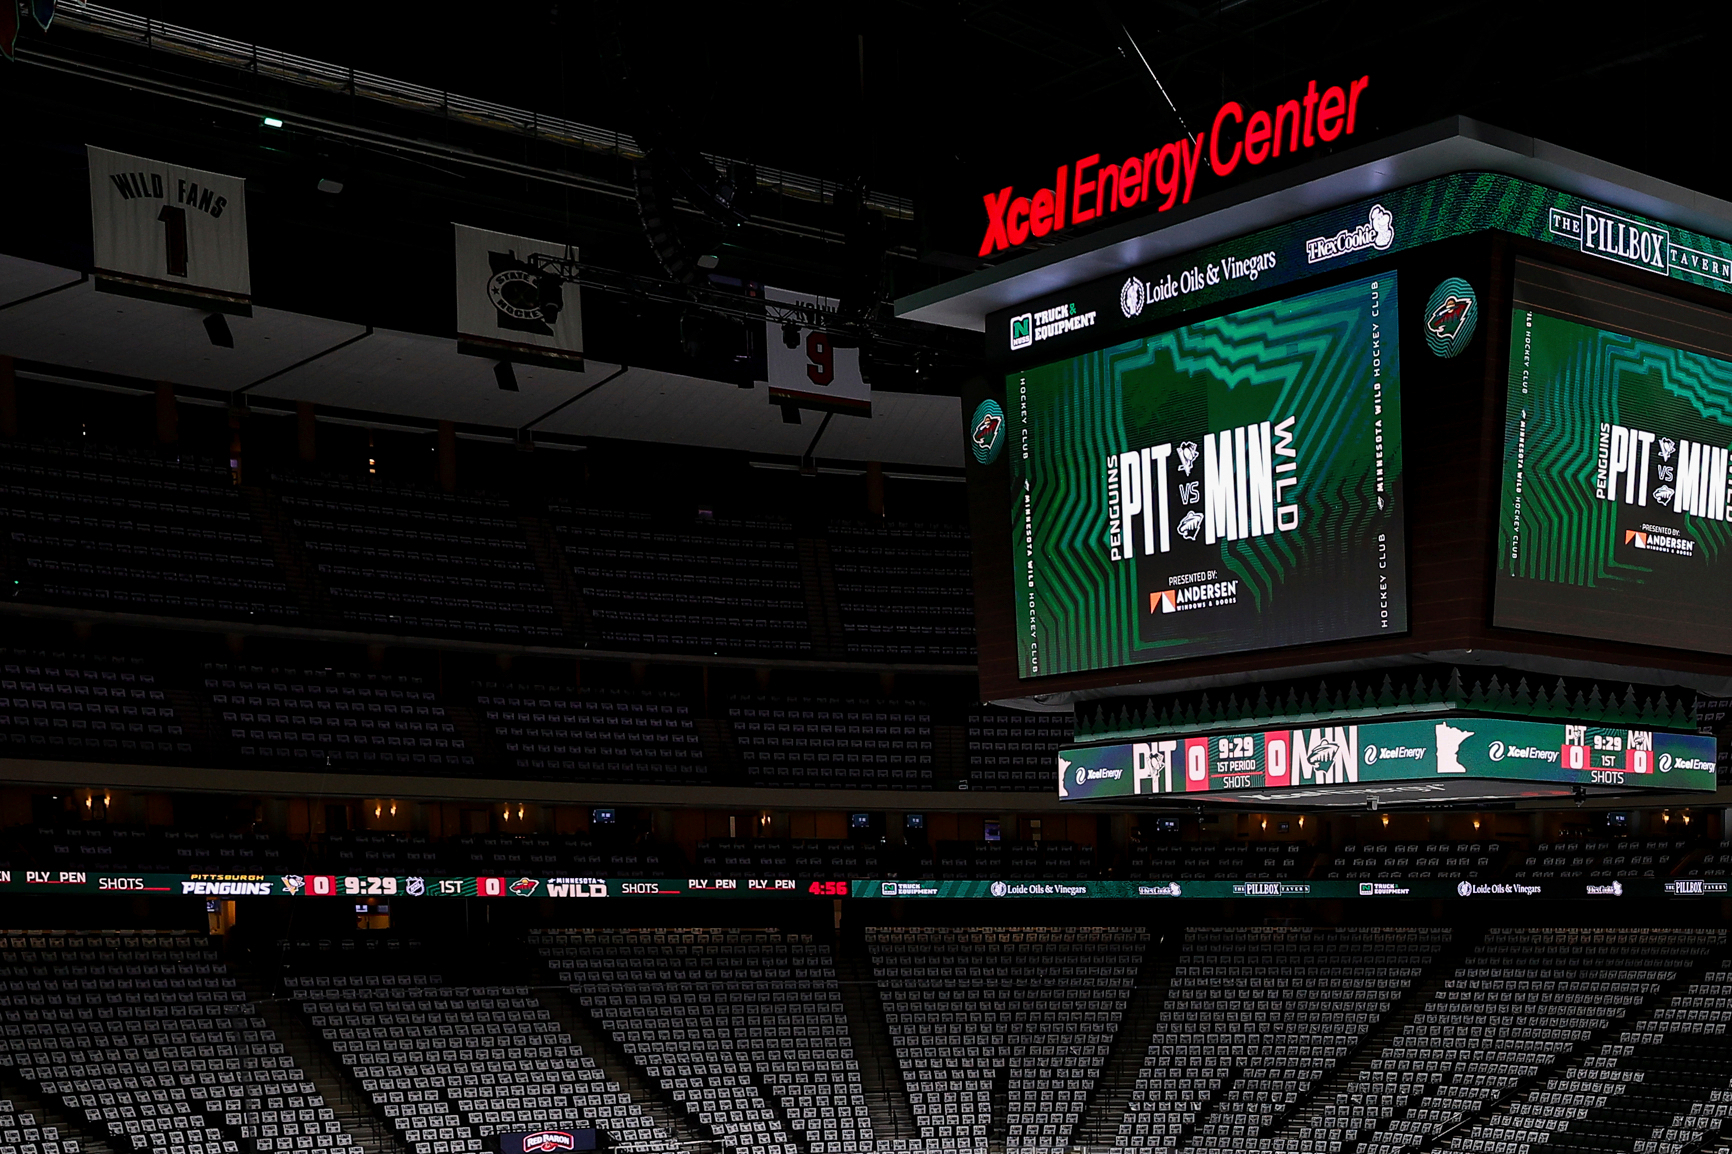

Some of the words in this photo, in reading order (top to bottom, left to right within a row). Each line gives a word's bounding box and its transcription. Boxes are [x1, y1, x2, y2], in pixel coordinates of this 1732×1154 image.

[978, 166, 1067, 257] Xcel
[1071, 133, 1204, 224] Energy
[1209, 75, 1369, 177] Center
[109, 171, 164, 201] WILD
[177, 178, 228, 219] FANS
[157, 205, 188, 278] 1
[1552, 213, 1580, 233] THE
[1584, 215, 1665, 269] PILLBOX
[1670, 248, 1732, 278] TAVERN
[1146, 271, 1177, 307] Loide
[1180, 267, 1205, 299] Oils
[1207, 264, 1219, 286] &
[1221, 249, 1278, 286] Vinegars
[499, 302, 542, 320] HOCKE
[1034, 304, 1068, 326] TRUCK
[1069, 303, 1077, 316] &
[1034, 311, 1096, 342] EQUIPMENT
[806, 331, 834, 386] 9
[1021, 426, 1030, 460] CLUB
[1596, 422, 1611, 499] PENGUINS
[1607, 424, 1656, 507] PIT
[1657, 465, 1674, 481] VS
[1673, 440, 1730, 521] MIN
[1107, 454, 1121, 562] PENGUINS
[1120, 443, 1172, 559] PIT
[1179, 482, 1200, 505] VS
[1204, 421, 1275, 545] MIN
[1273, 415, 1299, 533] WILD
[1646, 533, 1693, 551] ANDERSEN
[1168, 573, 1200, 587] PRESENTED
[1201, 570, 1218, 583] BY:
[1177, 581, 1236, 603] ANDERSEN
[1594, 735, 1622, 751] 9:29
[1188, 745, 1206, 781] 0
[1218, 736, 1255, 759] 9:29
[1267, 740, 1287, 777] 0
[1399, 746, 1426, 760] Energy
[1507, 745, 1530, 759] Xcel
[1529, 748, 1560, 763] Energy
[1571, 746, 1583, 769] 0
[1602, 755, 1616, 767] 1ST
[1634, 750, 1647, 773] 0
[1217, 761, 1230, 773] 1ST
[1230, 759, 1256, 772] PERIOD
[1223, 775, 1251, 789] SHOTS
[1591, 770, 1625, 785] SHOTS
[26, 872, 49, 883] PLY
[99, 878, 144, 890] SHOTS
[181, 881, 272, 895] PENGUINS
[313, 877, 330, 894] 0
[344, 878, 397, 894] 9:29
[439, 880, 464, 894] 1ST
[485, 879, 500, 895] 0
[621, 882, 659, 894] SHOTS
[689, 879, 708, 889] PLY
[748, 879, 767, 890] PLY
[774, 879, 796, 890] PEN
[809, 881, 847, 895] 4:56
[547, 884, 607, 898] WILD
[526, 1134, 541, 1146] RED
[542, 1133, 571, 1145] BARON
